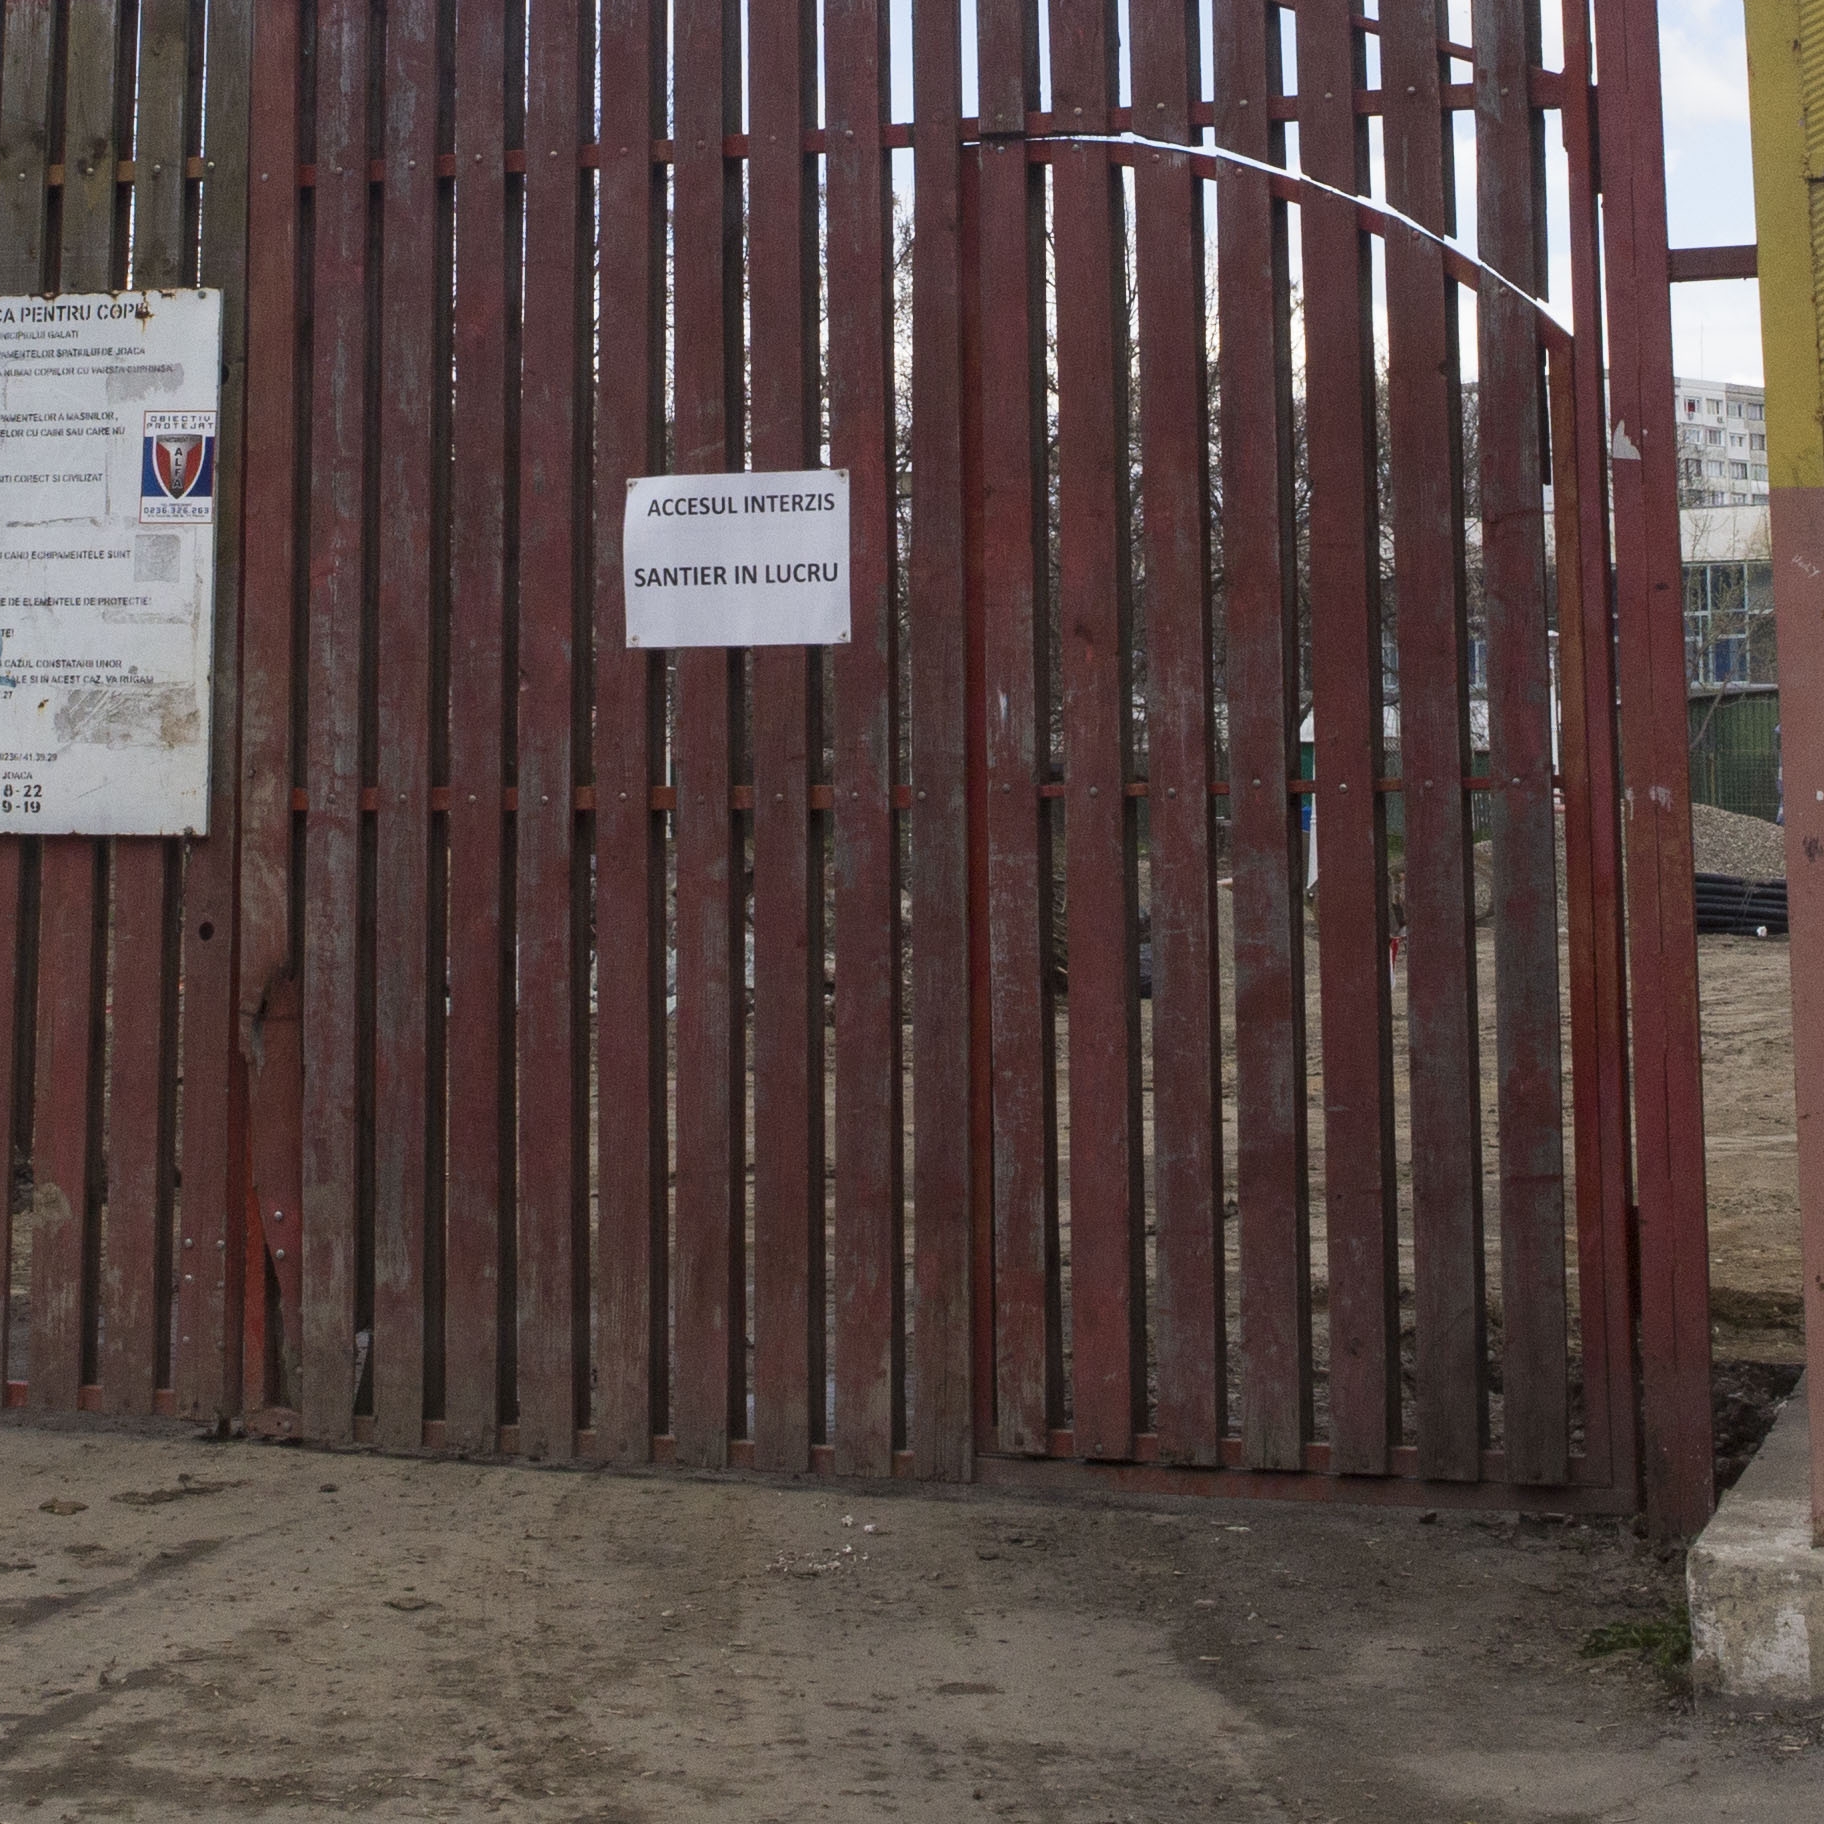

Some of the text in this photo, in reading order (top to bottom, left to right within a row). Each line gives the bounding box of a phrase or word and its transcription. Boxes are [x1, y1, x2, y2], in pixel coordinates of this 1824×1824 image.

[21, 304, 91, 323] PENTRU
[146, 422, 215, 430] PROTEJAT
[150, 415, 212, 423] OBIECTIV
[171, 447, 184, 489] ALFA
[647, 493, 835, 517] ACCESUL INTERZIS
[107, 550, 131, 559] SUNT
[634, 562, 838, 587] SANTIER IN LUCRU
